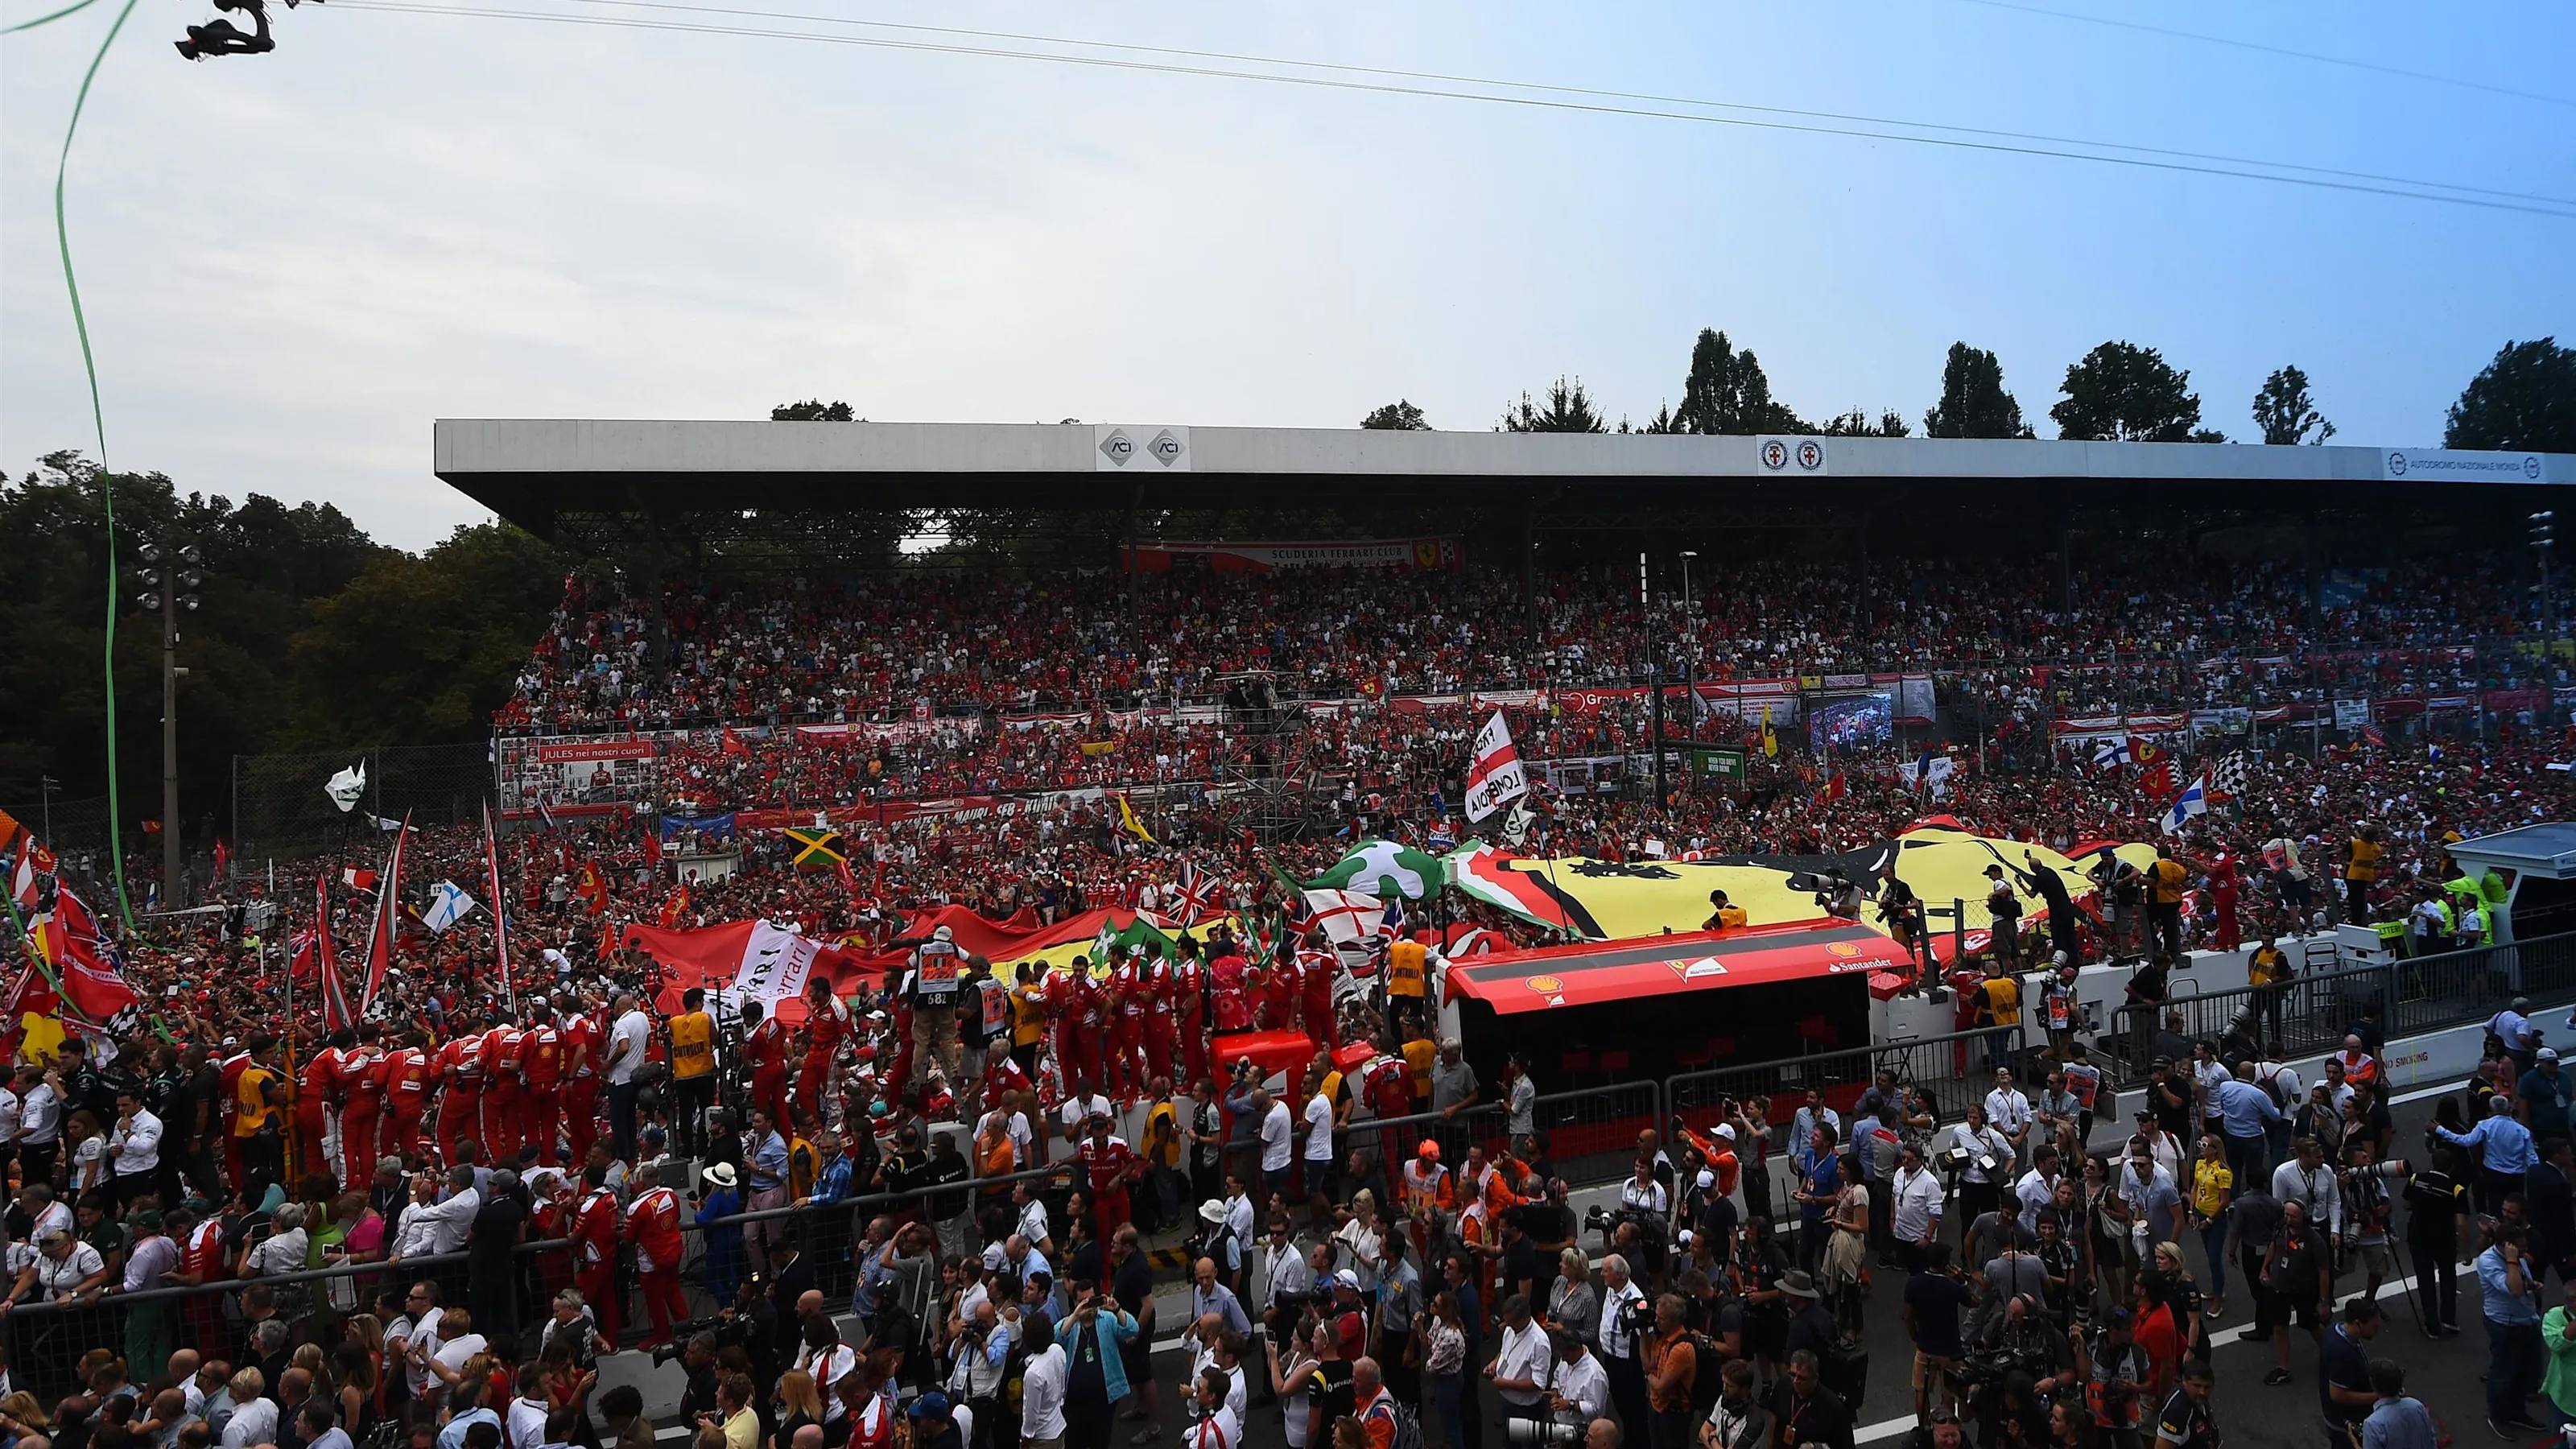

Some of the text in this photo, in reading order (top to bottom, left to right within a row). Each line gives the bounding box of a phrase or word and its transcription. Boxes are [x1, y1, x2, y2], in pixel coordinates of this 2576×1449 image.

[1112, 443, 1131, 452] ACI
[1159, 443, 1179, 452] ACI
[2410, 460, 2520, 471] AUTODROMO NAZIONALE MONZA
[1272, 547, 1402, 559] SCUDERIA FERRARI CLUB
[543, 745, 644, 761] JULES nei nostri cuori
[1839, 958, 1892, 972] Santander
[928, 993, 947, 1005] 682
[2396, 1051, 2428, 1067] SMOKING
